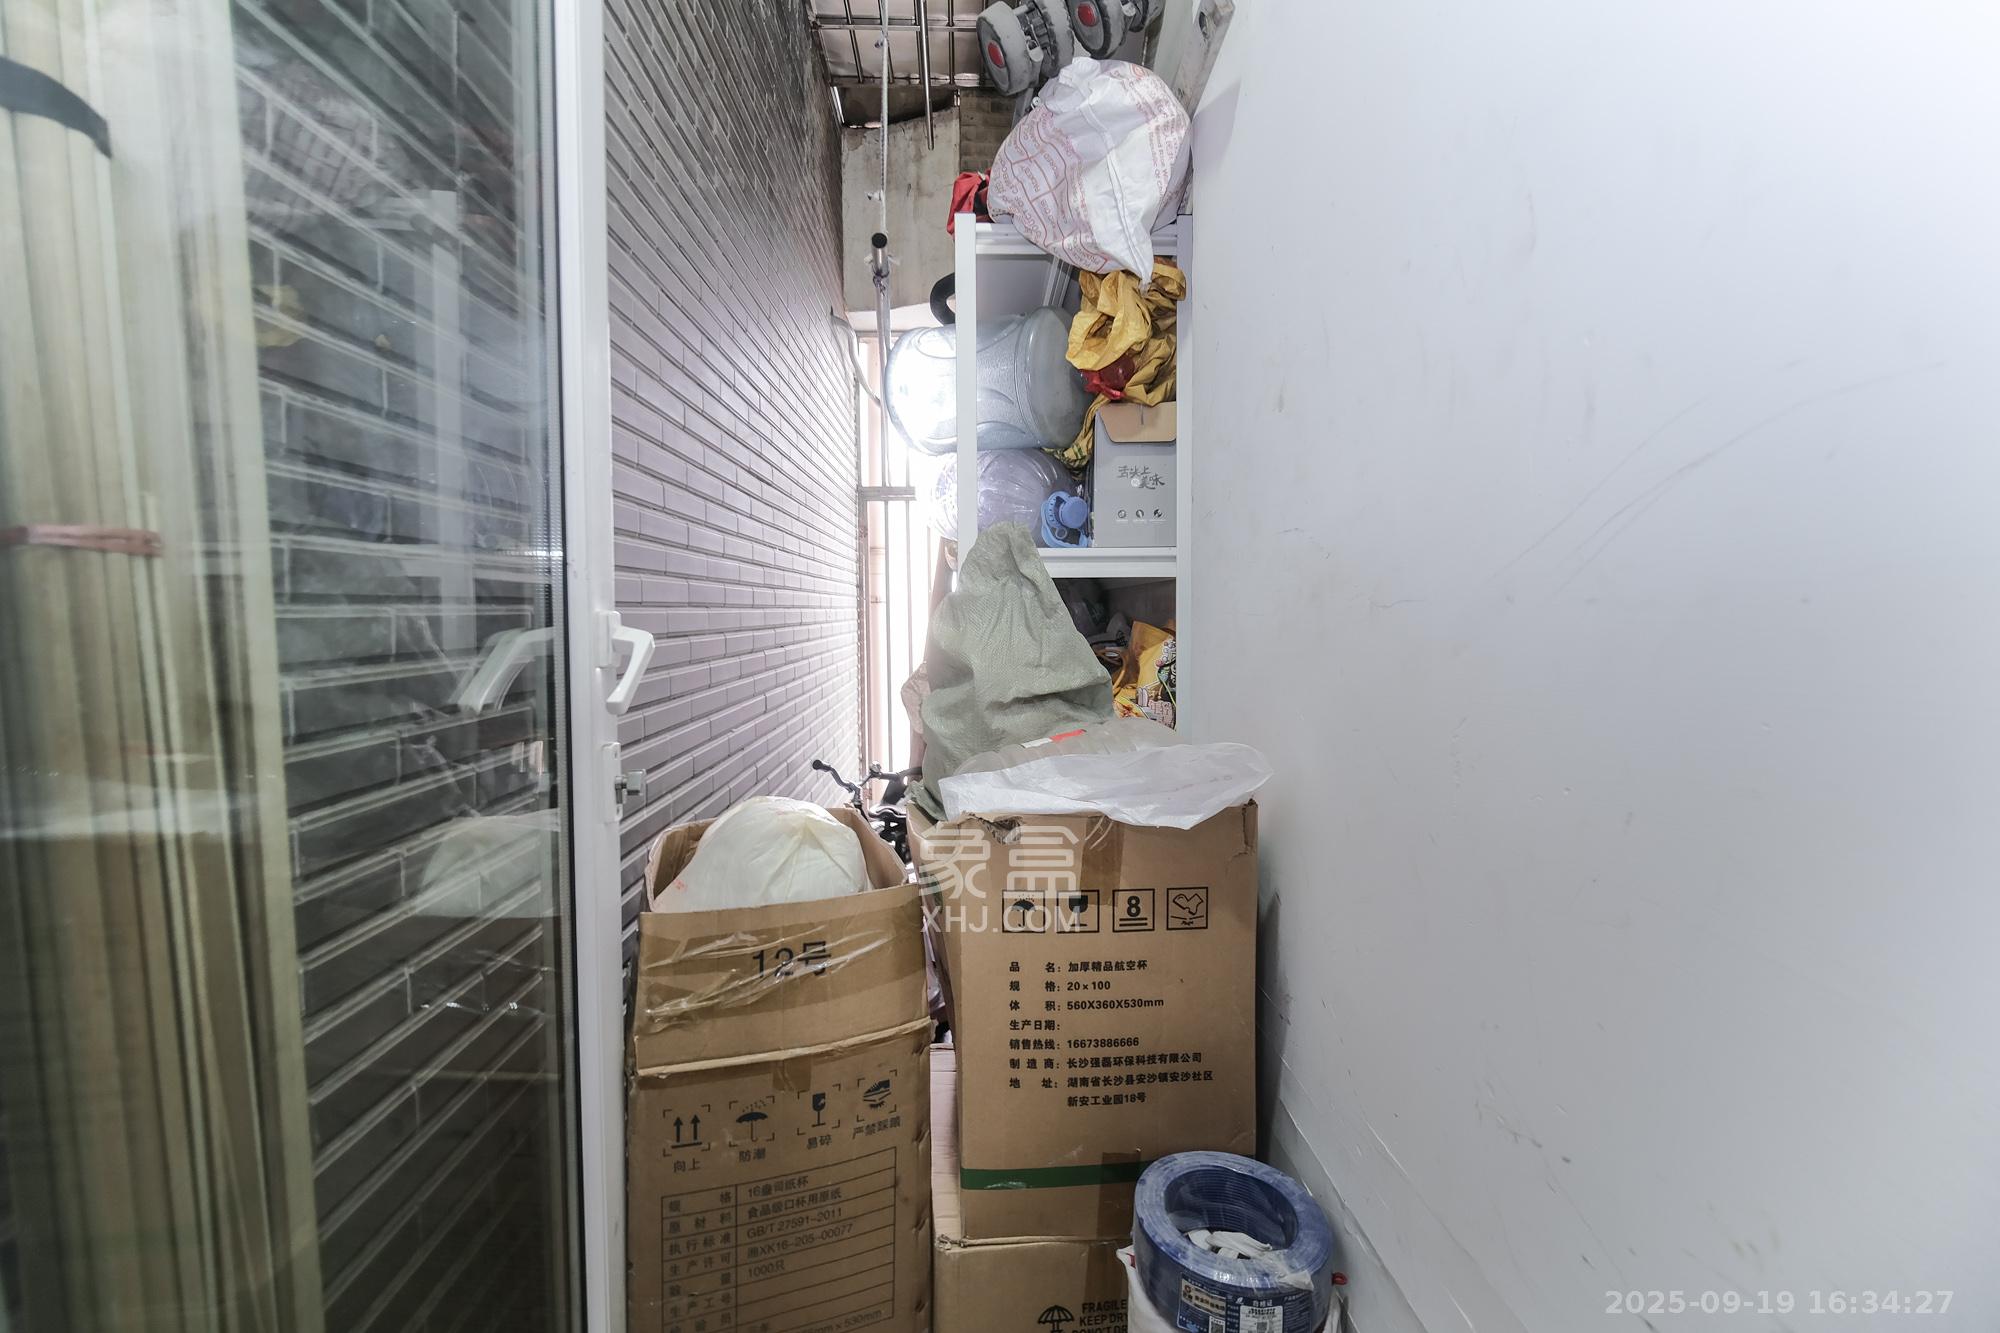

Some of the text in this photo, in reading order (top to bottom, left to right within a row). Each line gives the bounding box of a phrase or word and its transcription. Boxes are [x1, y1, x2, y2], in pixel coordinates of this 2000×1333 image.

[1127, 896, 1141, 918] 8
[1066, 998, 1165, 1011] 560X360X530mm
[1066, 1037, 1140, 1049] 16673886666
[673, 1158, 701, 1173] 向上
[1081, 1299, 1127, 1314] FRAGILE
[1080, 1313, 1108, 1327] KEEP
